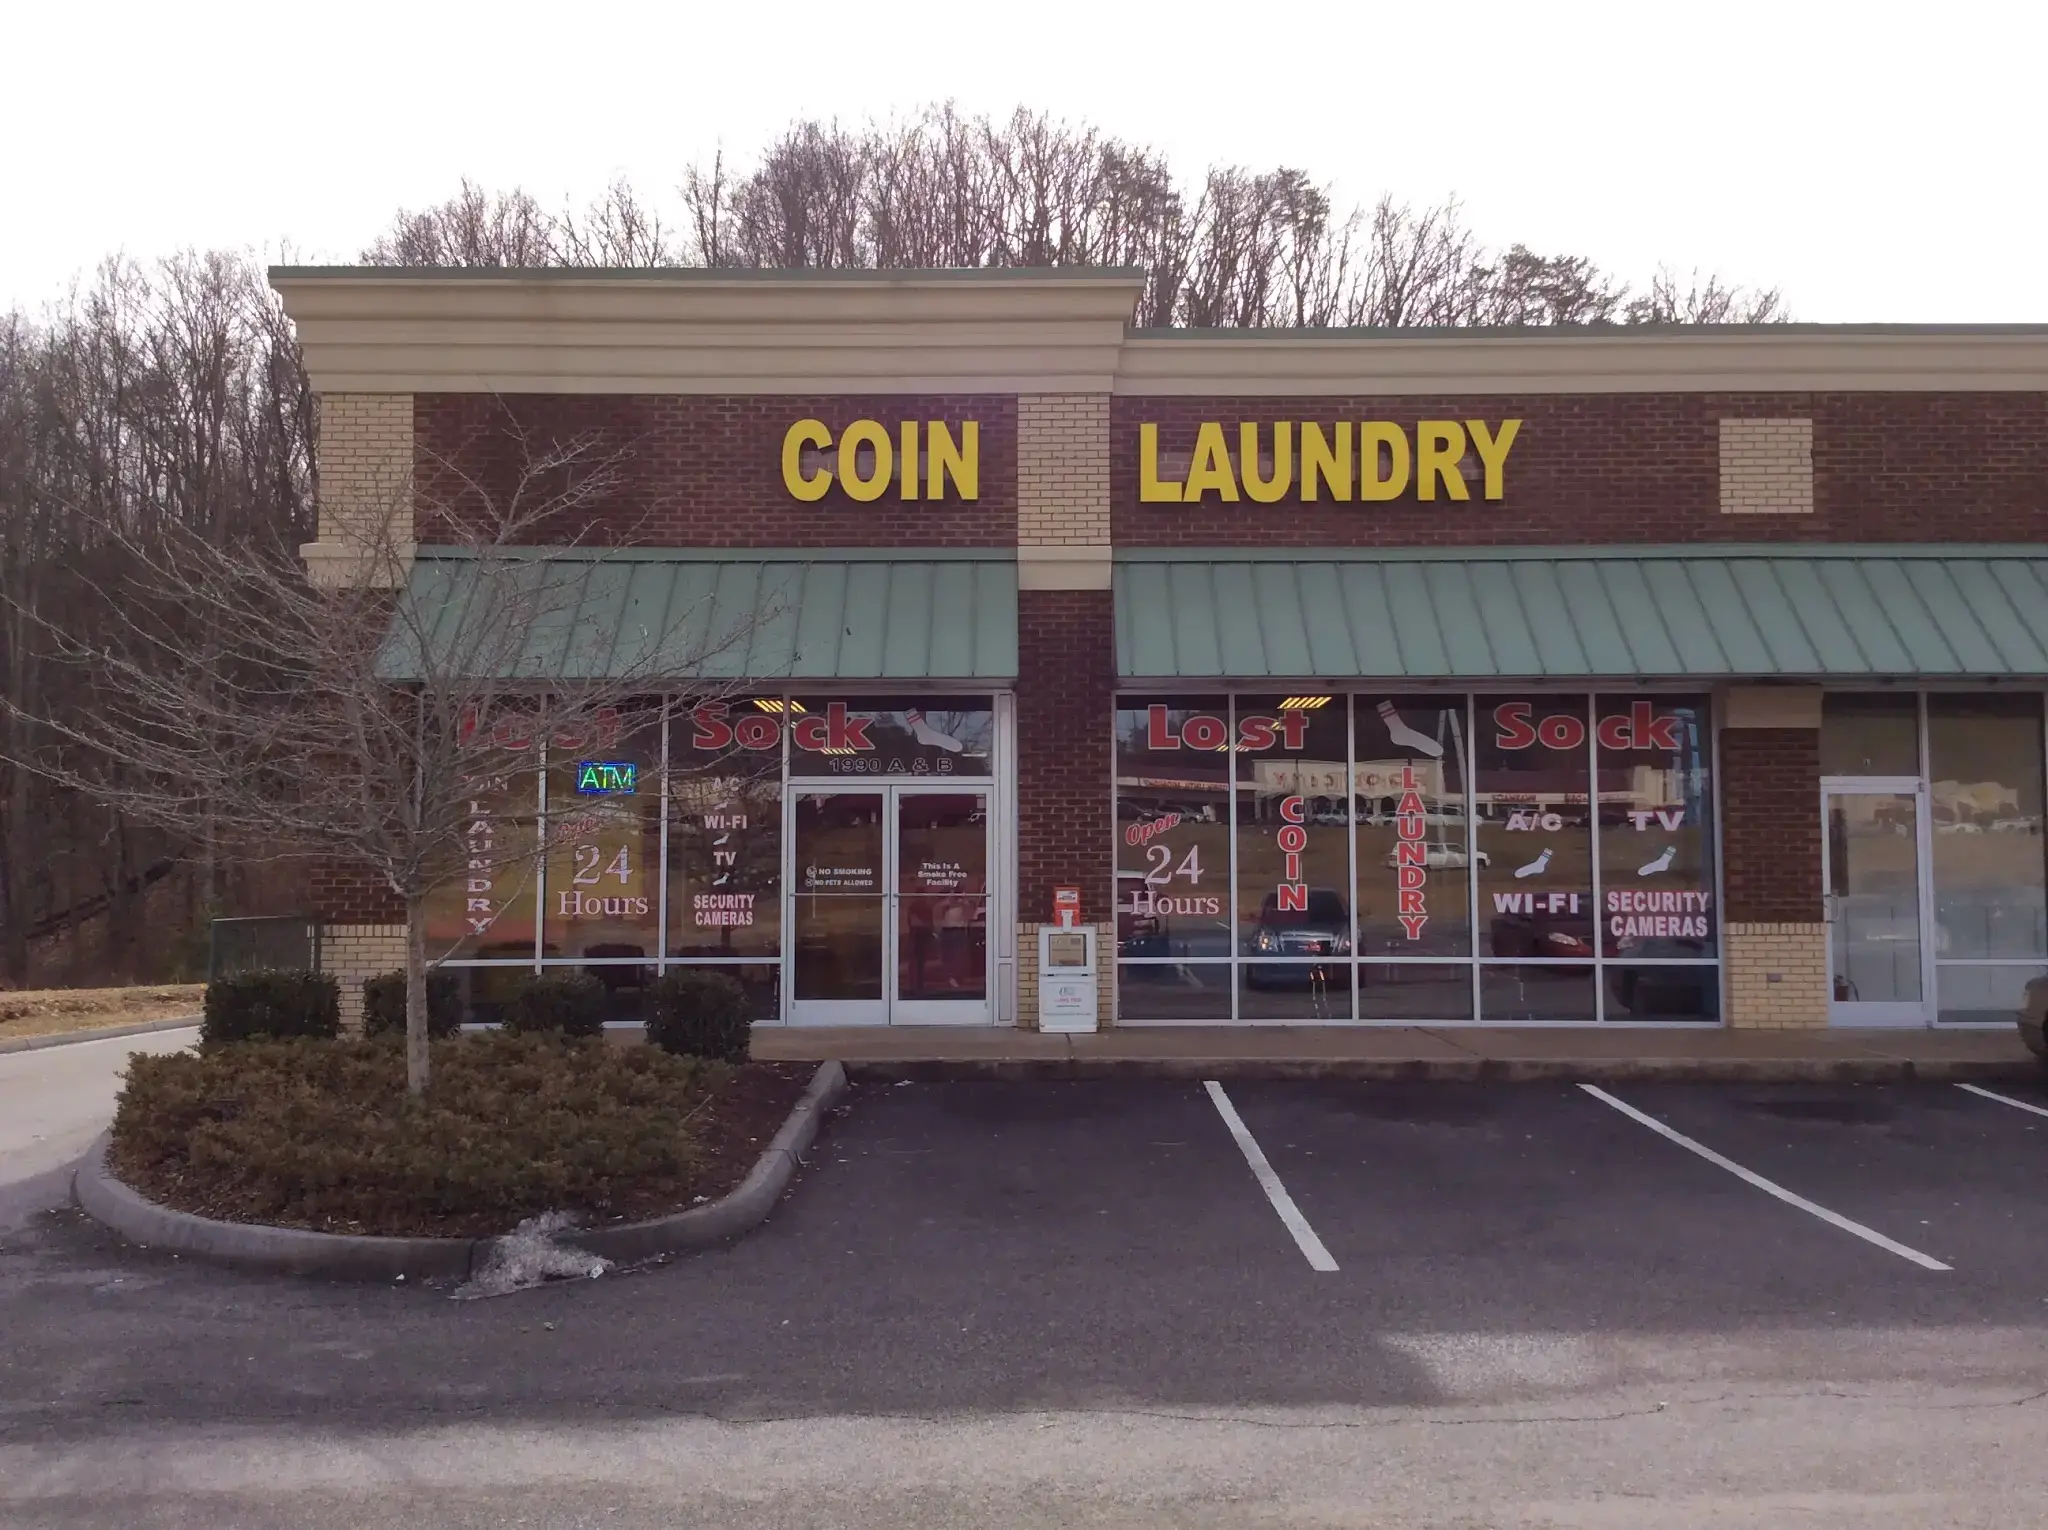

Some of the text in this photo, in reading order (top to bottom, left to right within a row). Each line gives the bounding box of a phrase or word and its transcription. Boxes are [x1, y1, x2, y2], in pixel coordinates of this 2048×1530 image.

[781, 418, 1523, 503] COIN LAUNDRY
[692, 701, 876, 751] Sock
[1147, 701, 1680, 750] Lost Sock
[829, 758, 953, 772] 1990 A & B
[581, 767, 632, 789] ATM
[703, 815, 748, 829] WI-FI
[1125, 812, 1181, 846] Open
[1505, 813, 1563, 831] A/C
[1627, 811, 1685, 831] TV
[713, 851, 737, 866] TV
[1277, 796, 1308, 911] COIN
[1396, 766, 1429, 940] LAUNDRY
[572, 844, 634, 885] 24
[818, 867, 872, 876] NO SMOKING
[917, 870, 946, 878] Smoke
[922, 862, 960, 870] This Is A
[1144, 844, 1205, 885] 24
[926, 878, 959, 887] Facility
[557, 890, 649, 916] Hours
[693, 894, 755, 909] SECURITY
[1130, 890, 1220, 916] Hours
[1493, 892, 1579, 914] WI-FI
[1607, 891, 1709, 913] SECURITY
[695, 911, 754, 926] CAMERAS
[1610, 915, 1708, 937] CAMERAS
